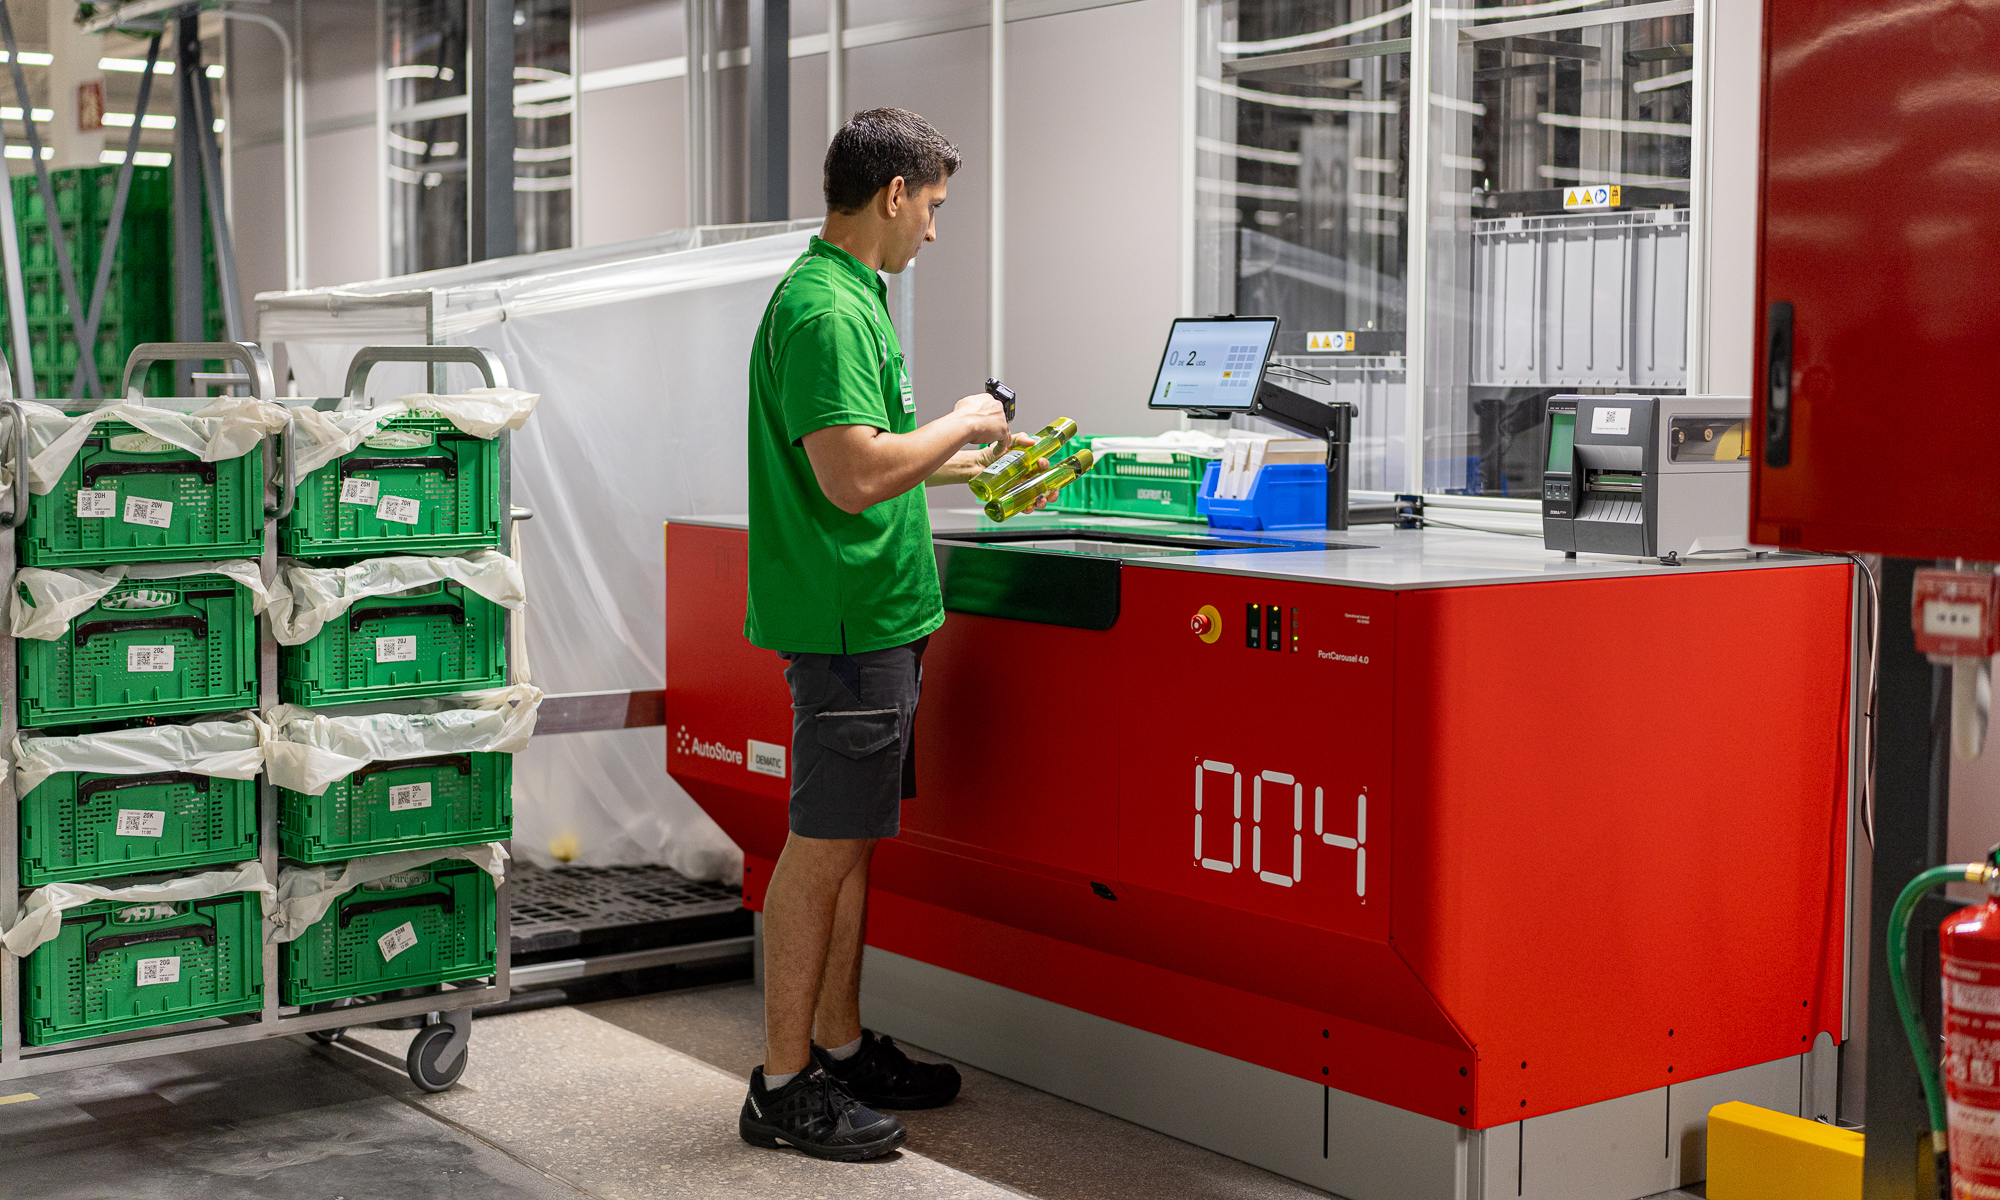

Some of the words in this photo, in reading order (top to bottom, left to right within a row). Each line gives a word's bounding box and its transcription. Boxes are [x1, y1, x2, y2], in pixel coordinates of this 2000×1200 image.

[1169, 350, 1179, 366] 0
[1186, 350, 1197, 366] 2
[151, 501, 162, 509] 20H
[1318, 649, 1358, 662] PortCarousel
[1358, 656, 1369, 664] 4.0
[691, 737, 743, 765] AutoStore
[756, 754, 782, 768] DEMATIC
[1194, 759, 1367, 897] 004
